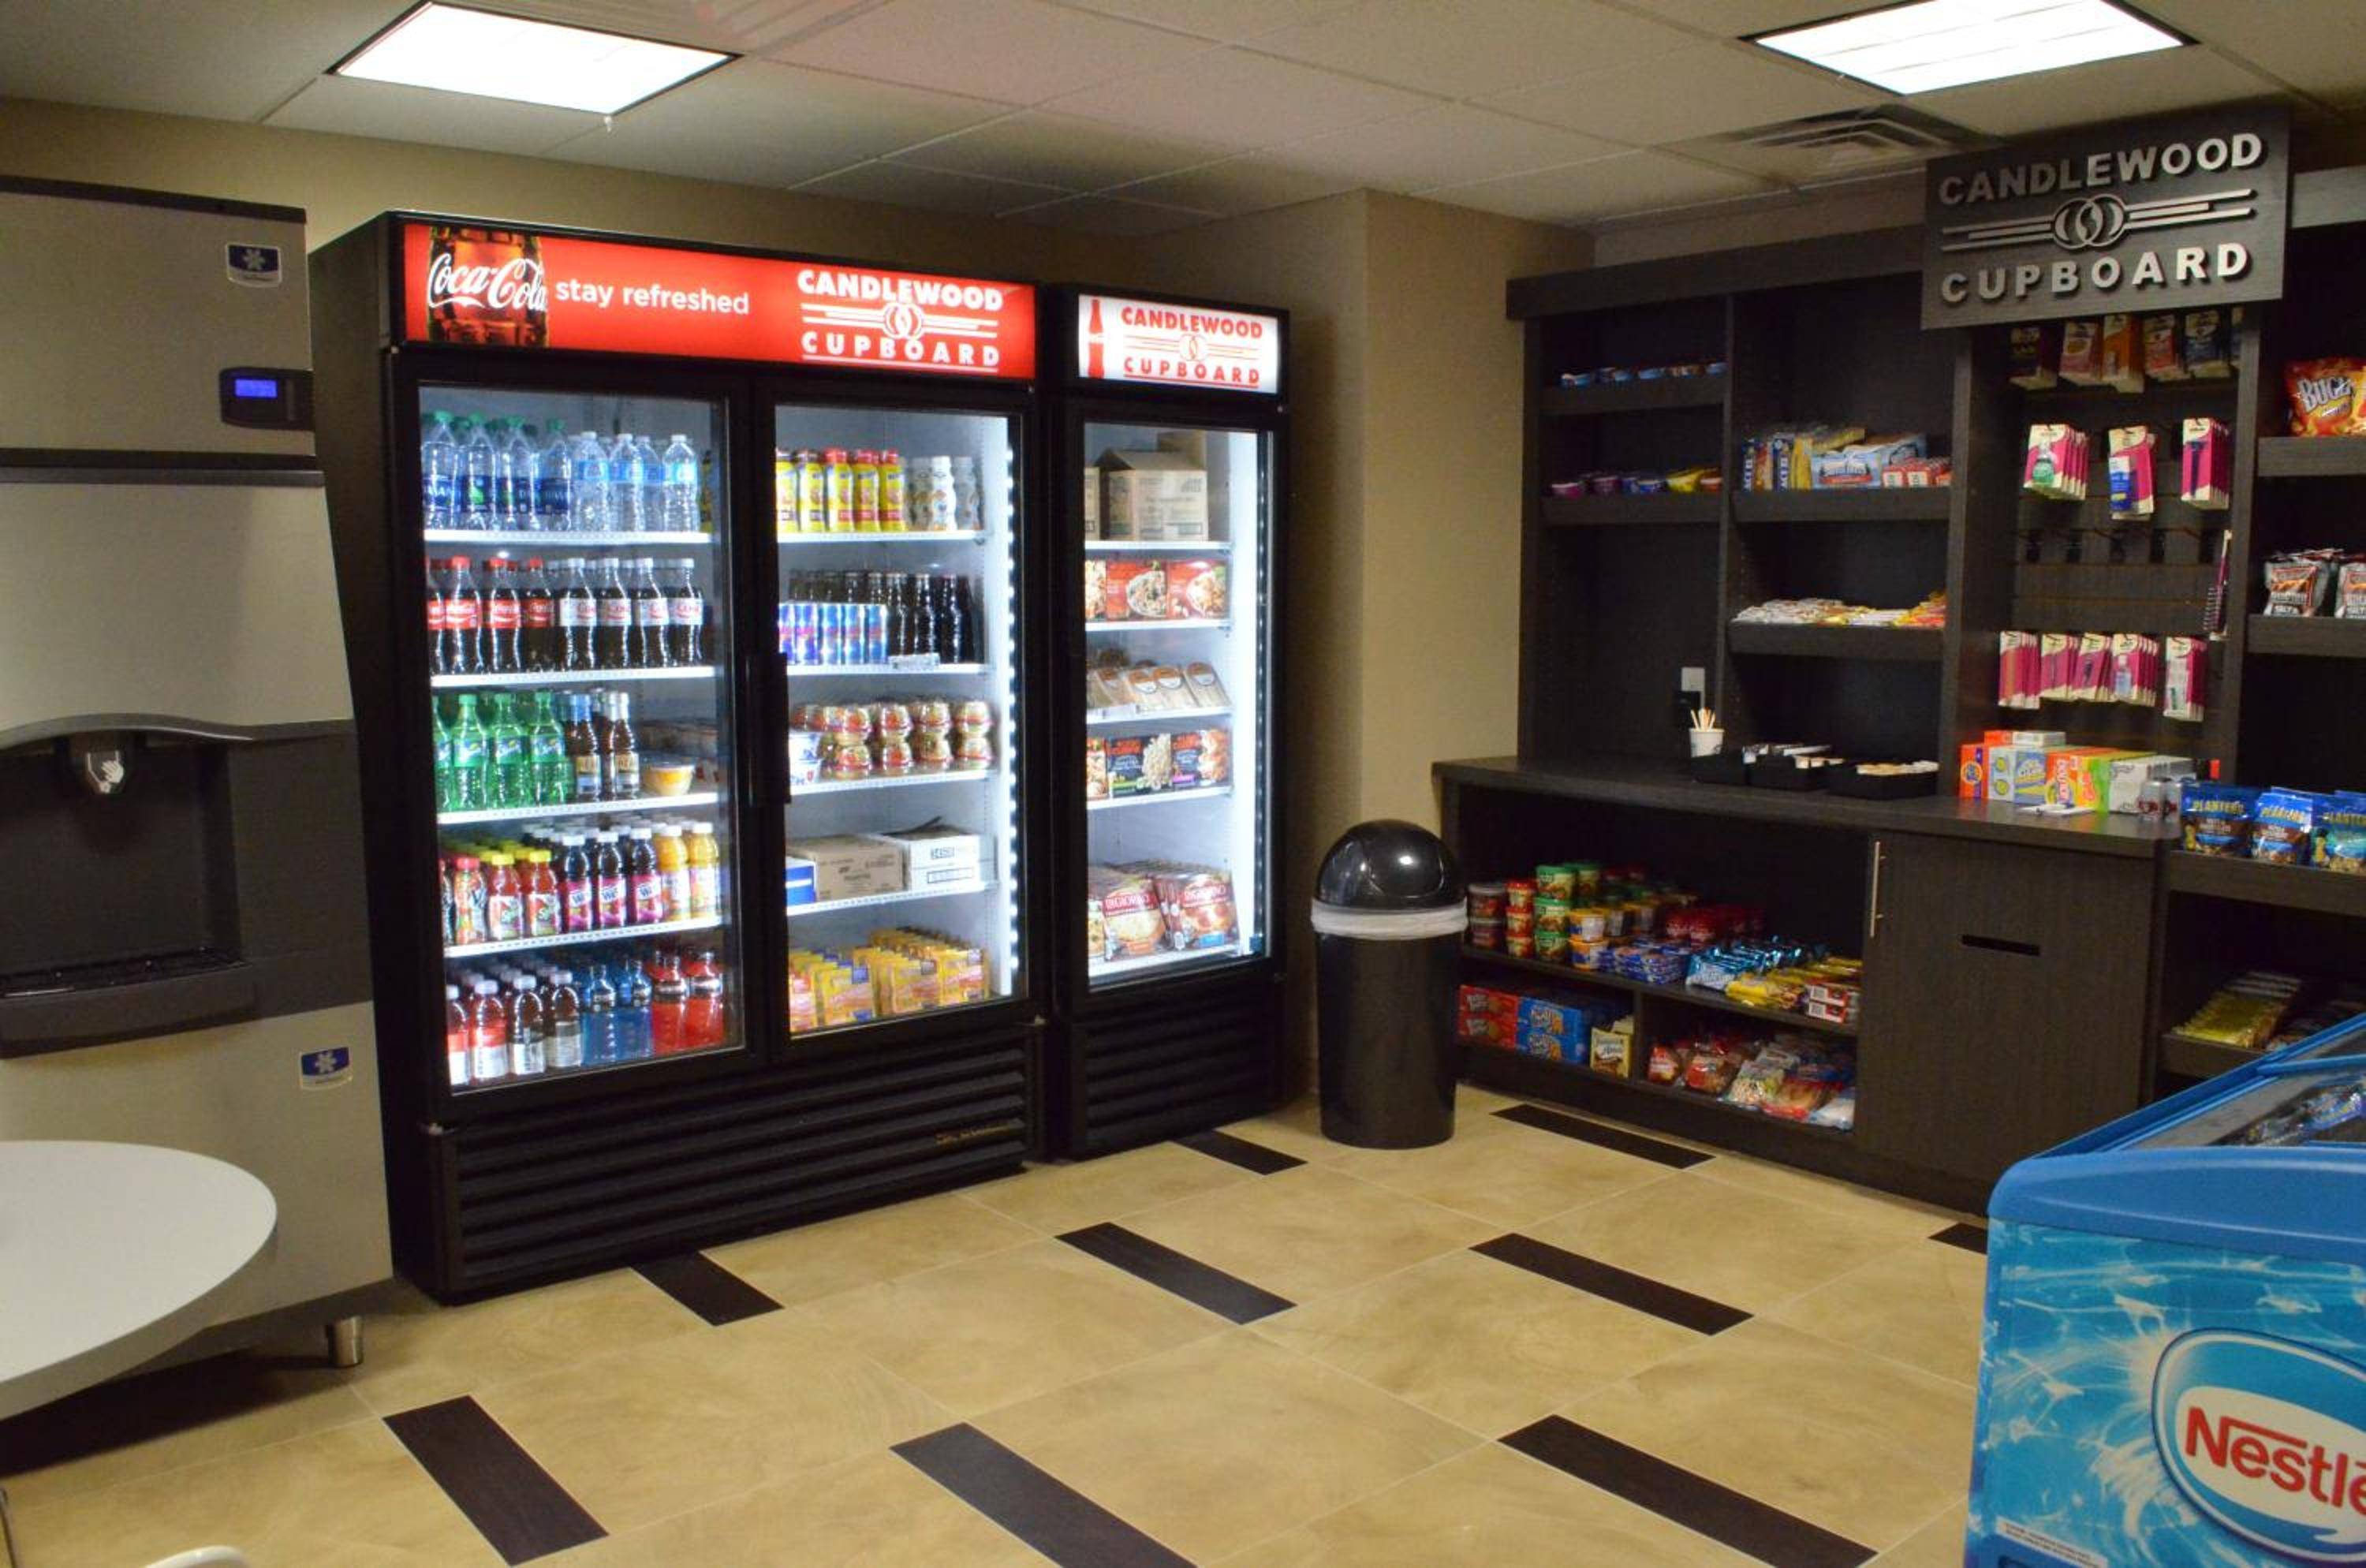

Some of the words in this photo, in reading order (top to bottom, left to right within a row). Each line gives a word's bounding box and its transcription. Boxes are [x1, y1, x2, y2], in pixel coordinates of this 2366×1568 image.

[1939, 133, 2263, 205] CANDLEWOOD
[427, 252, 548, 312] Coca-Cola
[797, 269, 1003, 312] CANDLEWOOD
[1941, 242, 2249, 303] CUPBOARD
[555, 278, 614, 308] stay
[622, 283, 749, 315] refreshed
[1121, 306, 1263, 338] CANDLEWOOD
[801, 331, 1000, 367] CUPBOARD
[1124, 357, 1260, 384] CUPBOARD
